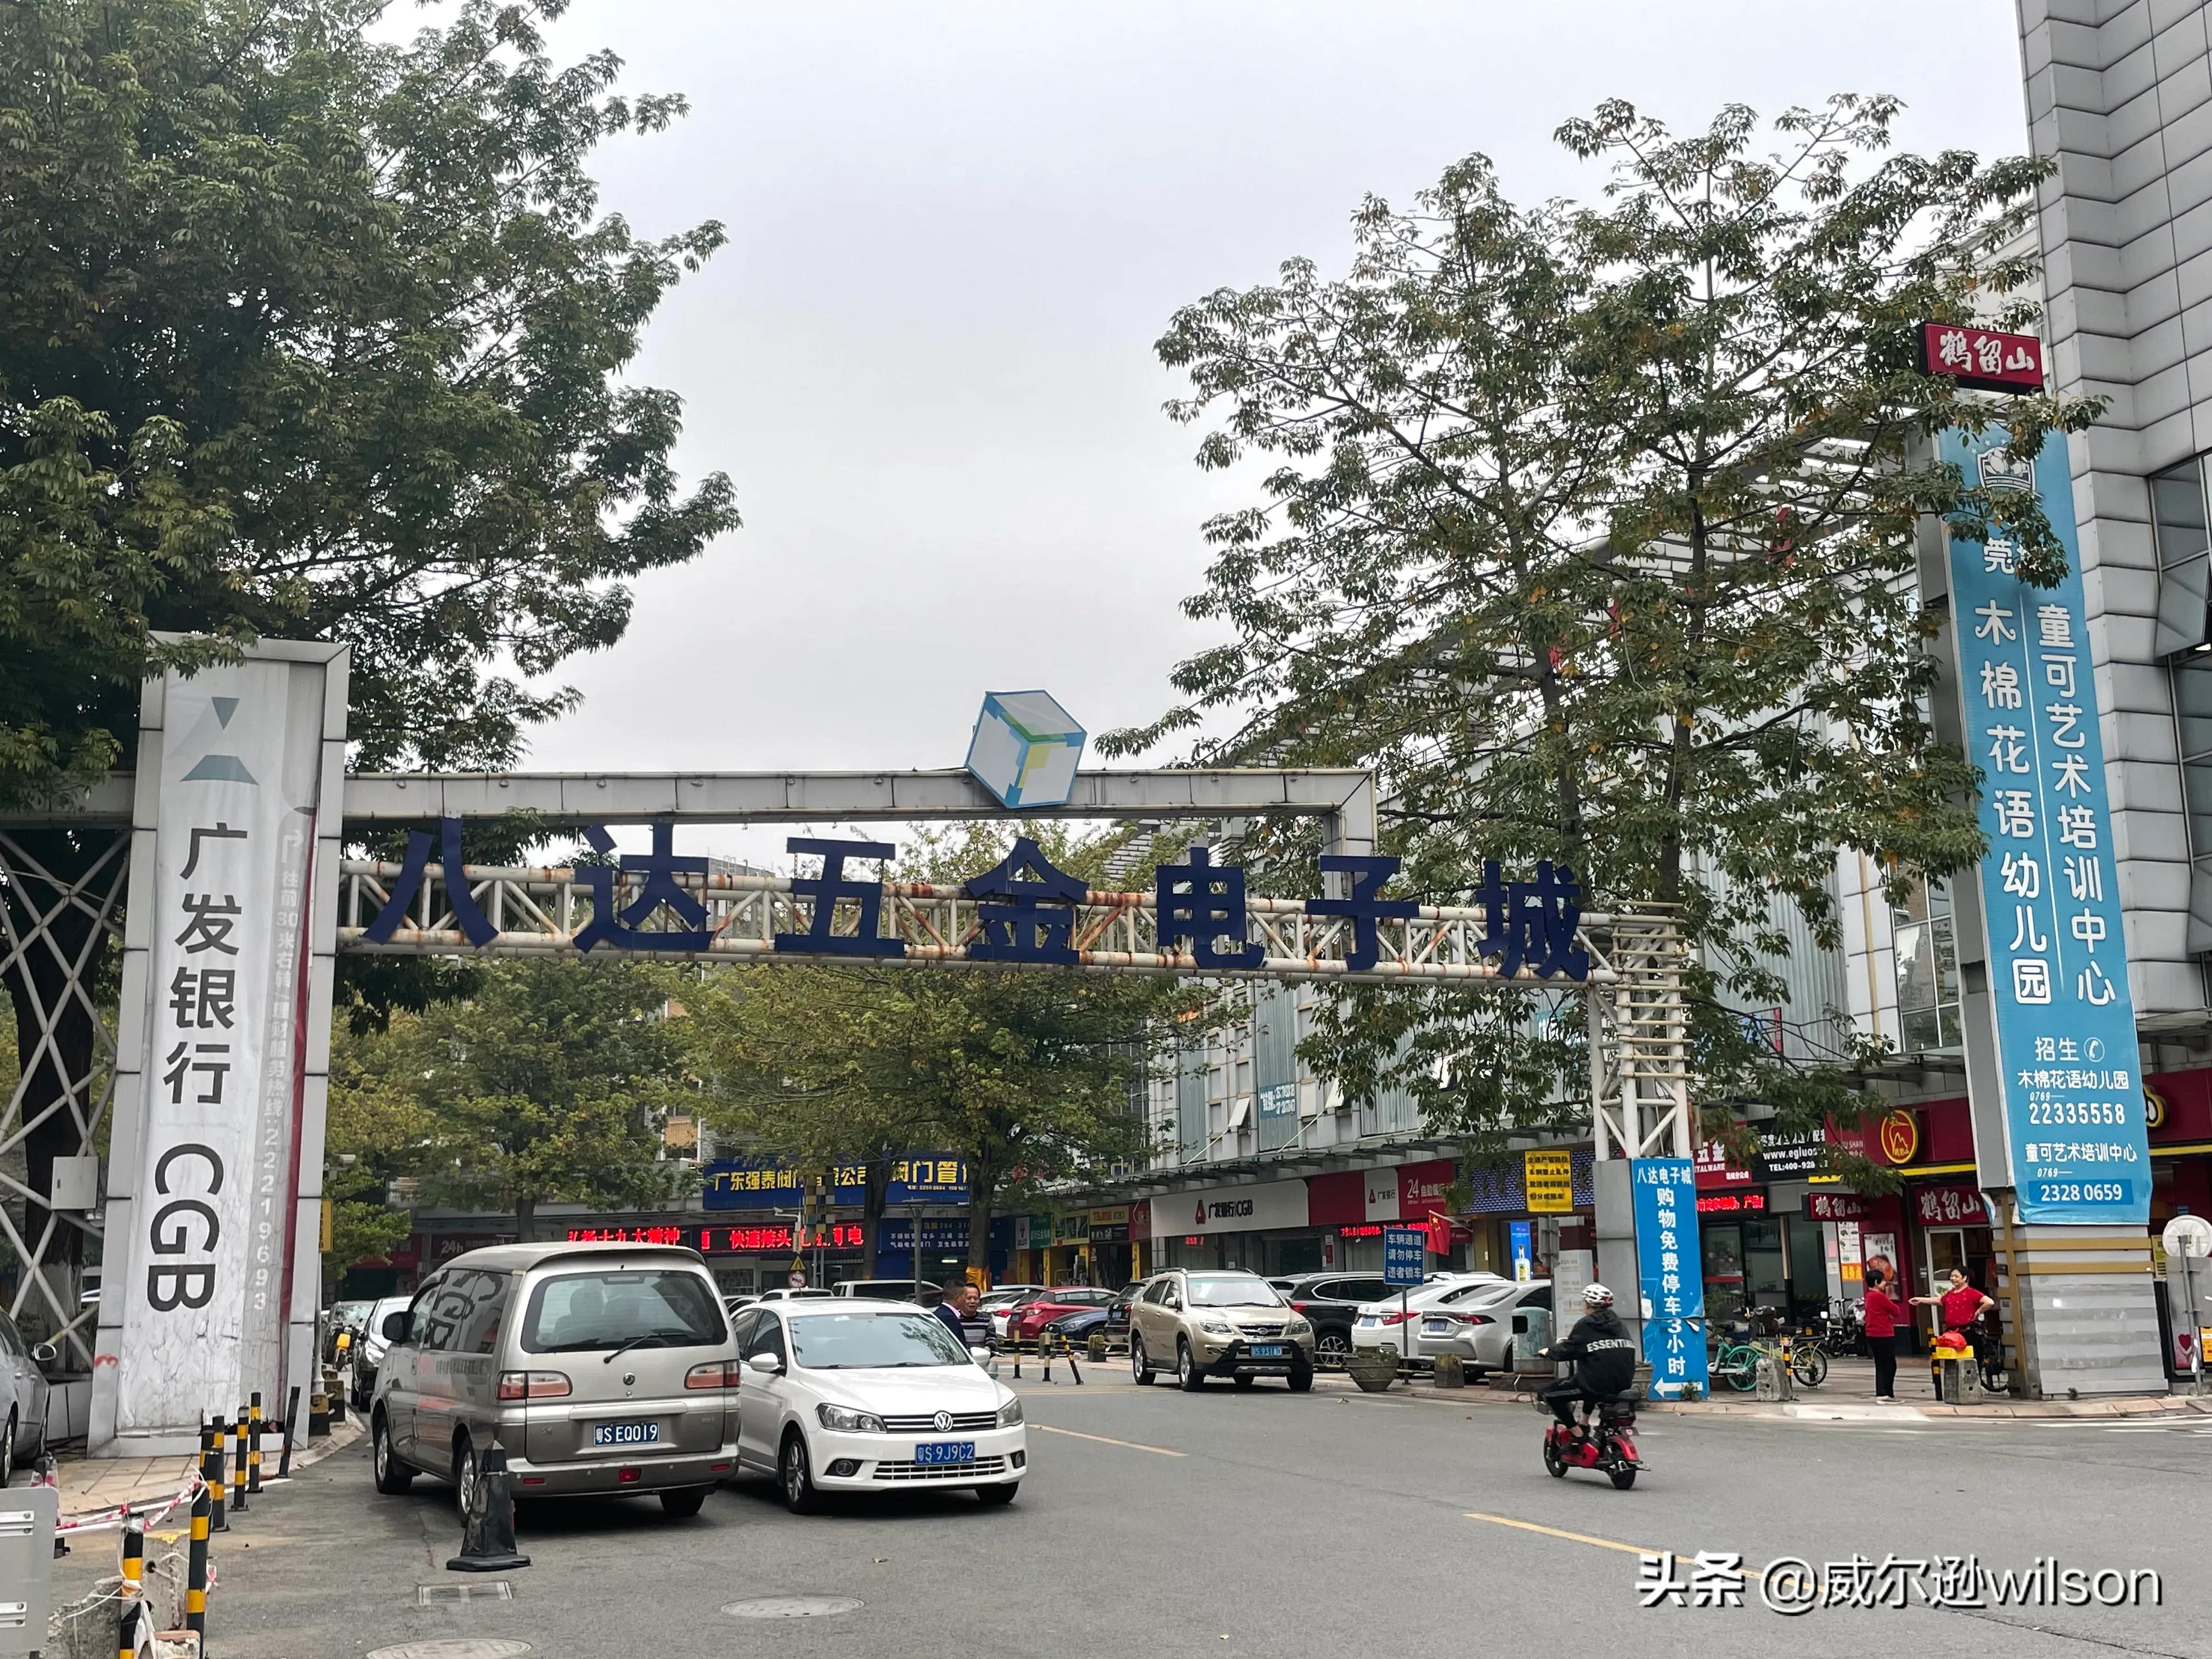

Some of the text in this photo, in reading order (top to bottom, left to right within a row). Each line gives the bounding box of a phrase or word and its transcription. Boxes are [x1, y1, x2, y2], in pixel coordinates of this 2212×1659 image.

[1975, 598, 2052, 1005] 木棉花语幼儿园
[2037, 603, 2117, 1007] 童可艺术培训中心
[362, 816, 1591, 981] 八达五金电子城
[2034, 1036, 2080, 1062] 招生
[147, 822, 248, 1312] 广发银行 CGB
[2017, 1069, 2129, 1090] 木棉花语幼儿园
[2029, 1102, 2125, 1125] 22335558
[2024, 1142, 2138, 1163] 童可艺术培训中心
[1637, 1165, 1693, 1186] 八达电子城
[1407, 1178, 1419, 1199] 24
[2040, 1183, 2123, 1201] 2328 0659
[1387, 1233, 1422, 1246] 车辆通道
[1387, 1249, 1422, 1261] 请勿停车
